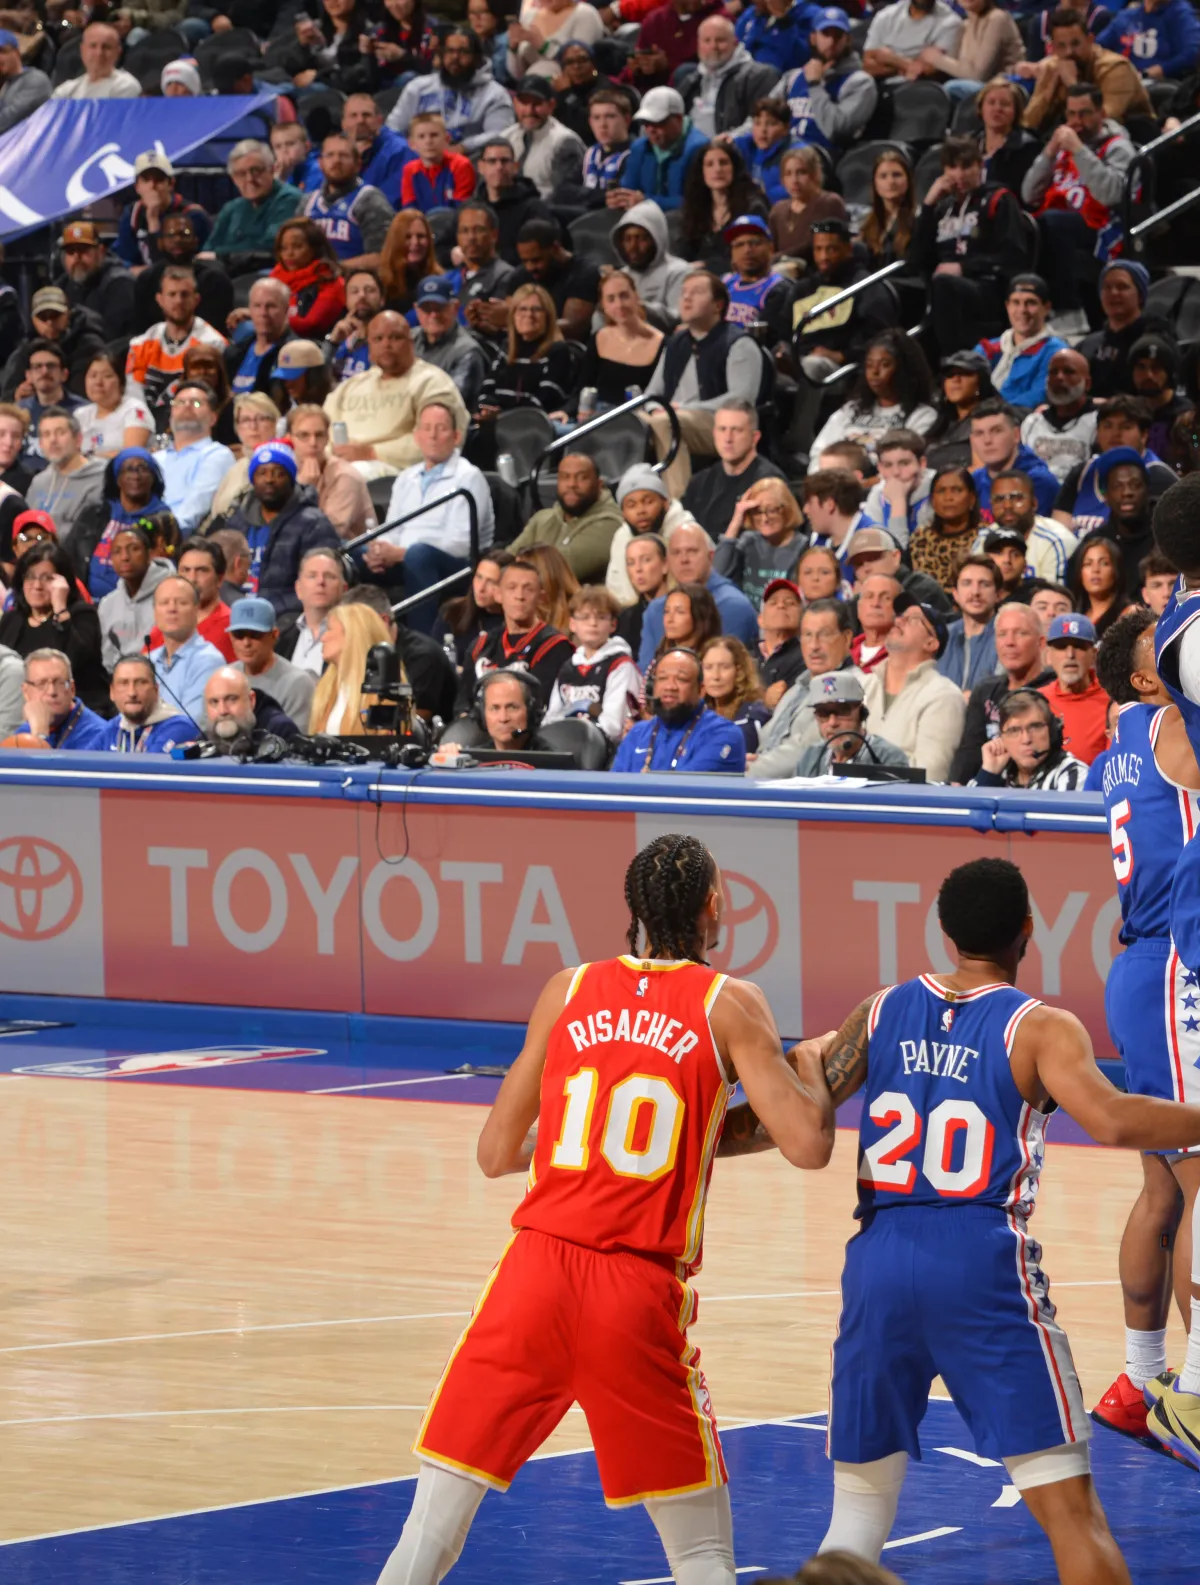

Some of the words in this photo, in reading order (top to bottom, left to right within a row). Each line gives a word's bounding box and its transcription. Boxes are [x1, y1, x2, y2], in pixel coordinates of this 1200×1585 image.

[1102, 754, 1143, 798] GRIMES
[1110, 798, 1135, 886] 5
[147, 846, 581, 967] TOYOTA
[567, 1009, 700, 1065] RISACHER
[900, 1040, 980, 1084] PAYNE
[551, 1066, 687, 1182] 10
[858, 1091, 996, 1198] 20
